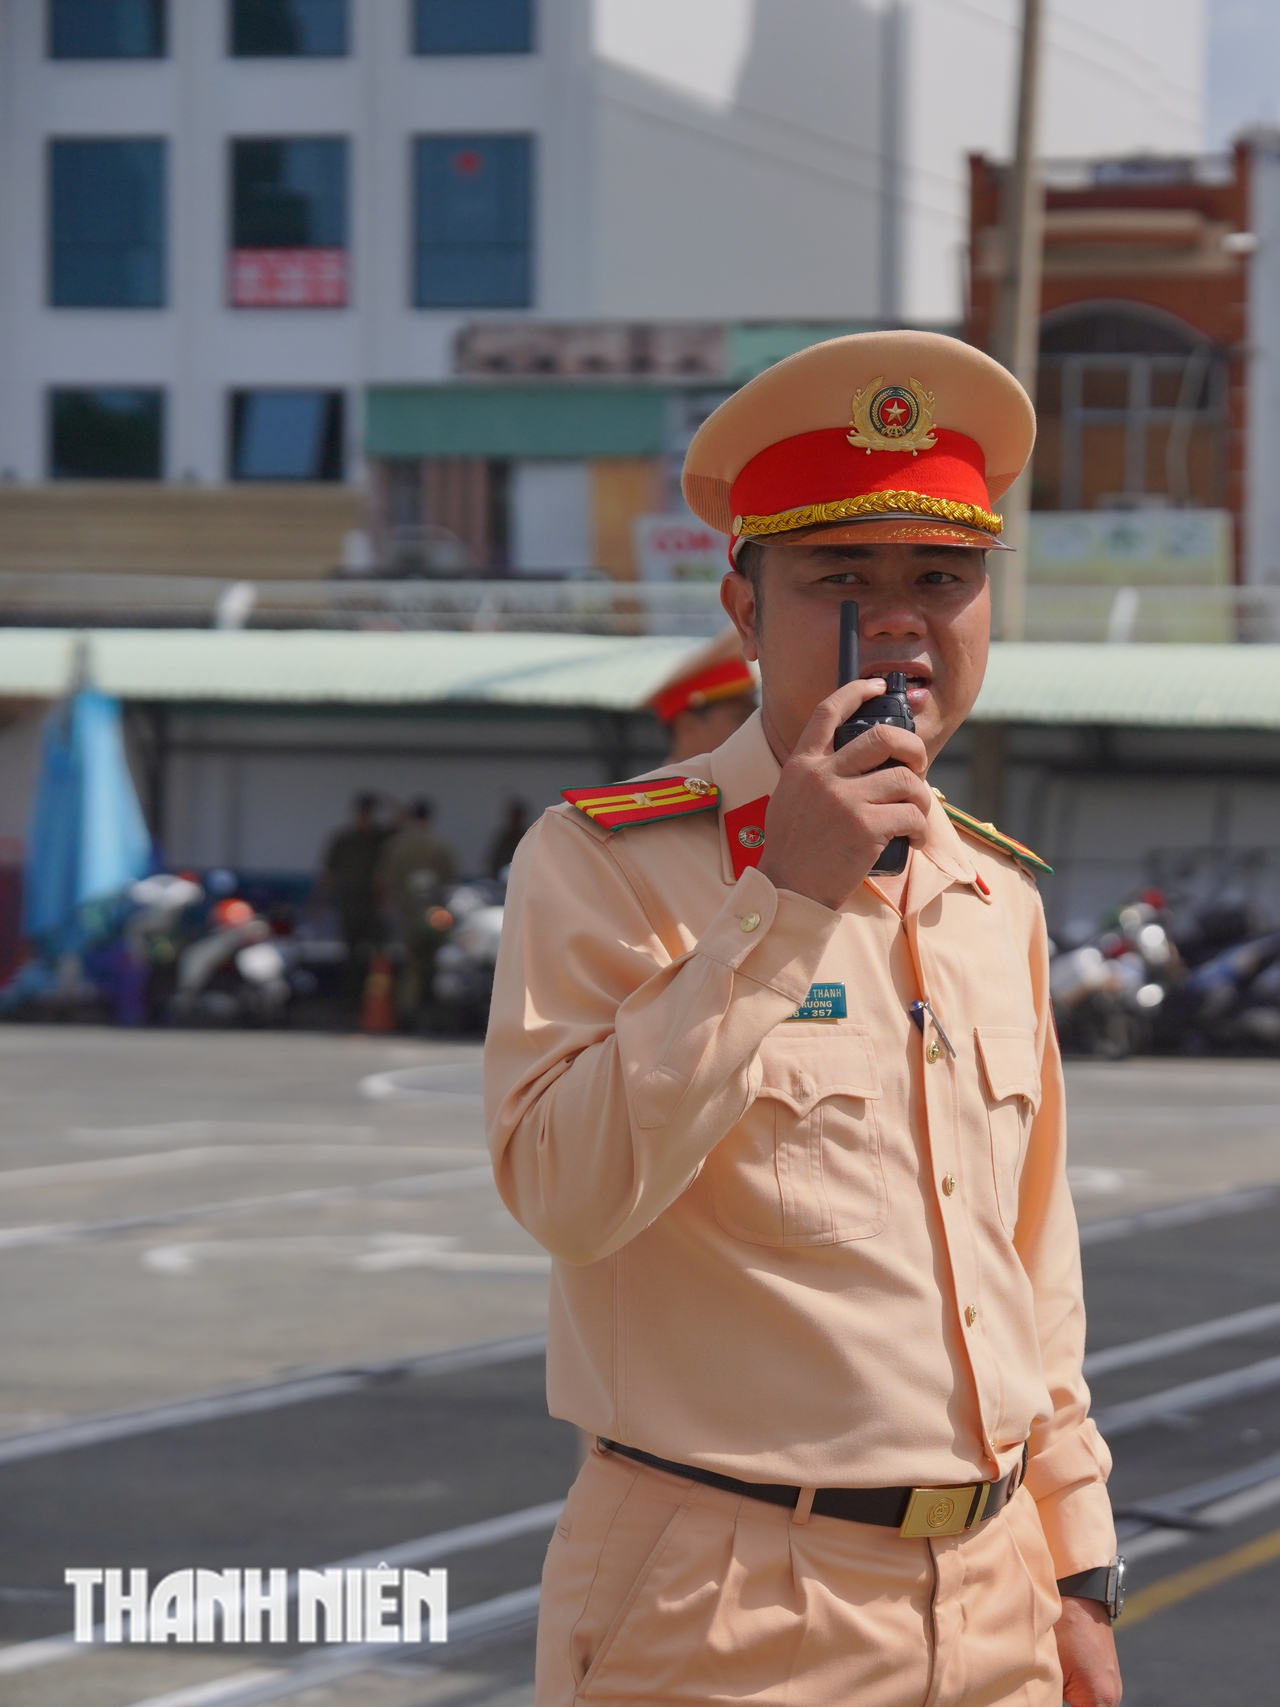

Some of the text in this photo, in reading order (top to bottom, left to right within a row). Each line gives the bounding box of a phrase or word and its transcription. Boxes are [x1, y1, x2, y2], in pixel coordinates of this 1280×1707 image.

[812, 986, 842, 998] THÀNH
[801, 998, 832, 1008] RƯỞNG
[811, 1009, 832, 1017] 357
